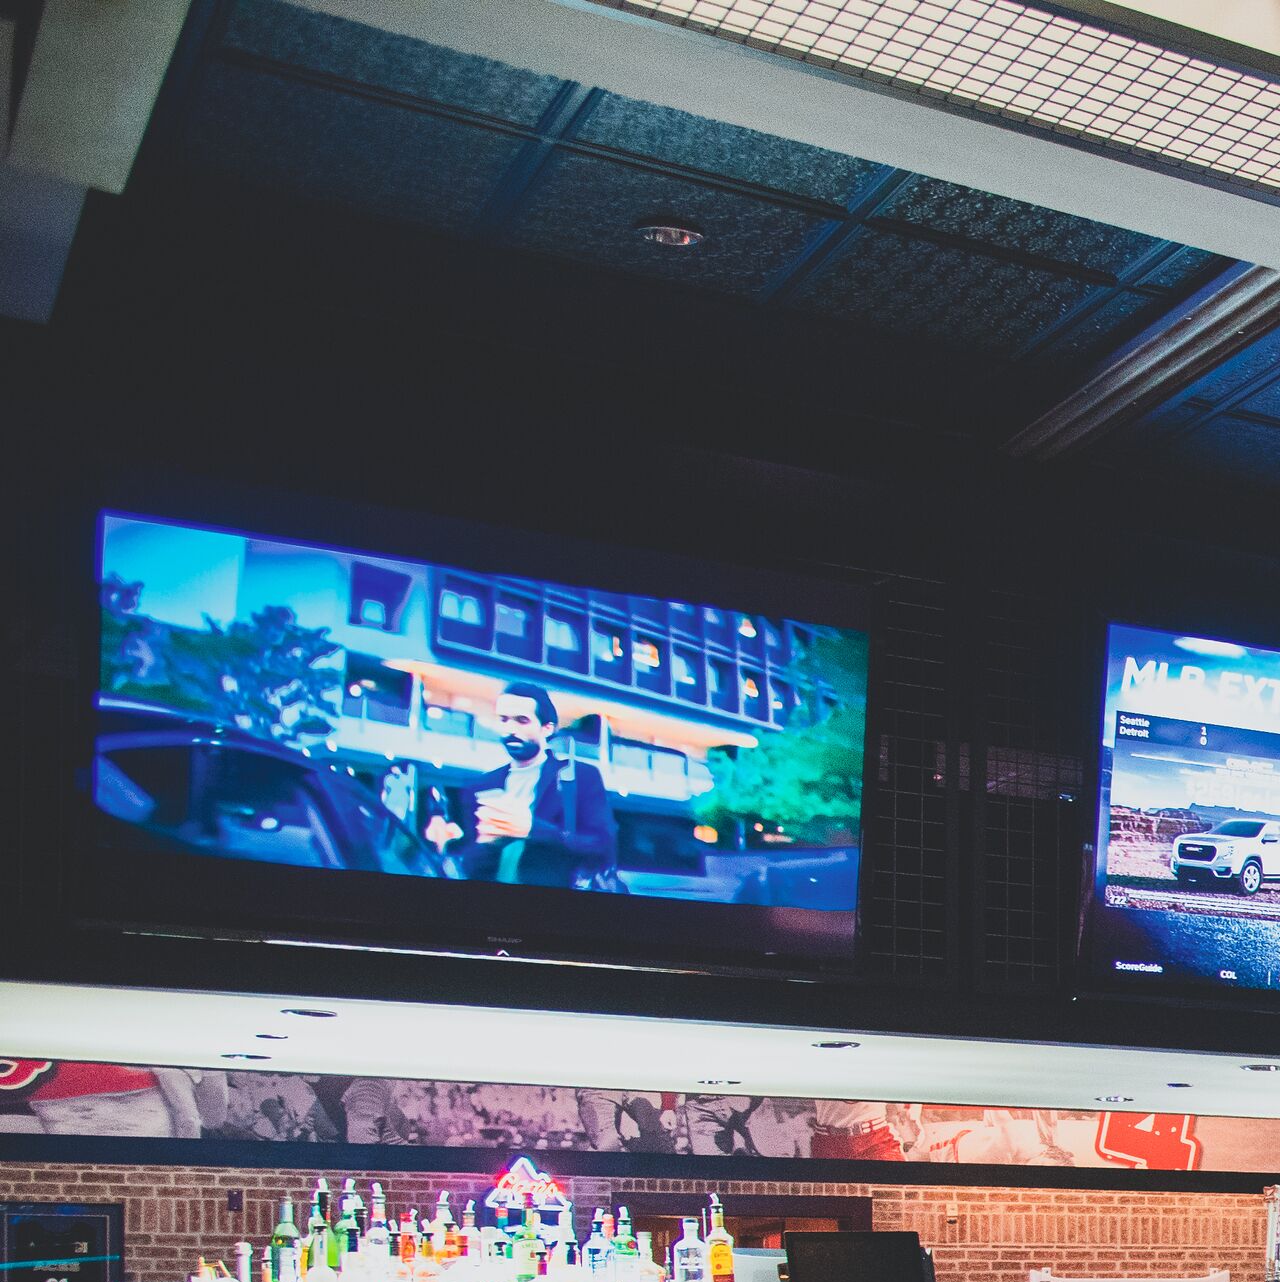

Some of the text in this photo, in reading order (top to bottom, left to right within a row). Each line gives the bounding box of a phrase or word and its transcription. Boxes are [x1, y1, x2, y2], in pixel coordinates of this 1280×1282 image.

[1119, 714, 1207, 736] Seattle 1
[1119, 726, 1149, 738] Detroit
[1116, 961, 1163, 973] ScoreGuide
